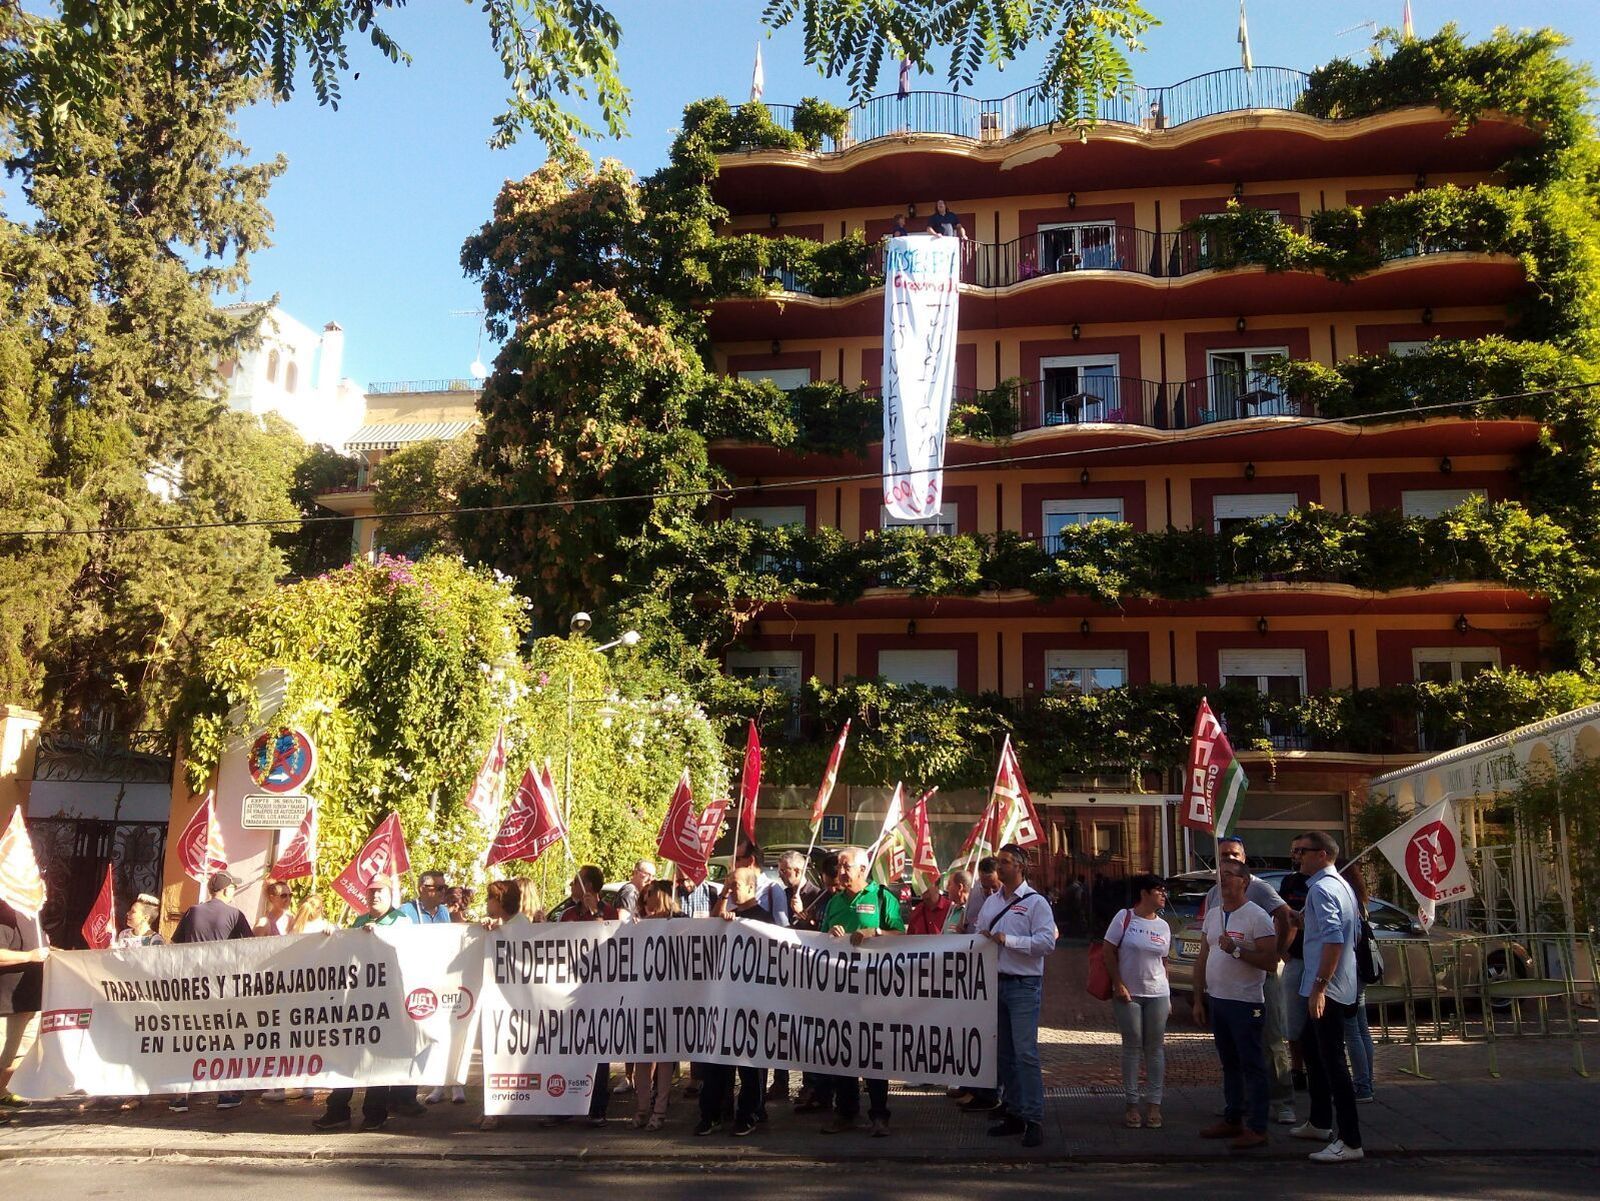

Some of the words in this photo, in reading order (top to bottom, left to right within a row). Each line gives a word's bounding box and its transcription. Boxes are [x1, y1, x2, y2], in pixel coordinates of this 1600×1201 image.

[1188, 712, 1222, 823] CCOO
[829, 817, 838, 831] H
[102, 976, 210, 1001] TRABAJADORES
[217, 975, 226, 999] Y
[233, 964, 358, 998] TRABAJADORAS
[366, 962, 386, 988] DE
[494, 940, 516, 984] EN
[521, 938, 602, 984] DEFENSA
[607, 937, 638, 982] DEL
[643, 934, 727, 982] CONVENIO
[730, 934, 830, 992] COLECTIVO
[835, 951, 861, 994] DE
[865, 940, 988, 1001] HOSTELERÍA
[408, 993, 434, 1007] UGT
[135, 1008, 248, 1032] HOSTELERÍA
[257, 1009, 281, 1028] DE
[290, 1002, 390, 1026] GRANADA
[140, 1036, 163, 1054] EN
[173, 1034, 235, 1053] LUCHA
[244, 1031, 281, 1051] POR
[290, 1025, 381, 1049] NUESTRO
[493, 1009, 504, 1055] Y
[507, 1008, 531, 1055] SU
[535, 996, 637, 1055] APLICACIÓN
[643, 1007, 667, 1054] EN
[673, 1006, 718, 1055] TODOS
[721, 1008, 759, 1058] LOS
[765, 1011, 852, 1068] CENTROS
[859, 1021, 884, 1070] DE
[890, 1023, 981, 1077] TRABAJO
[192, 1054, 323, 1081] CONVENIO
[489, 1076, 528, 1088] CCOO
[491, 1092, 531, 1102] ervicios
